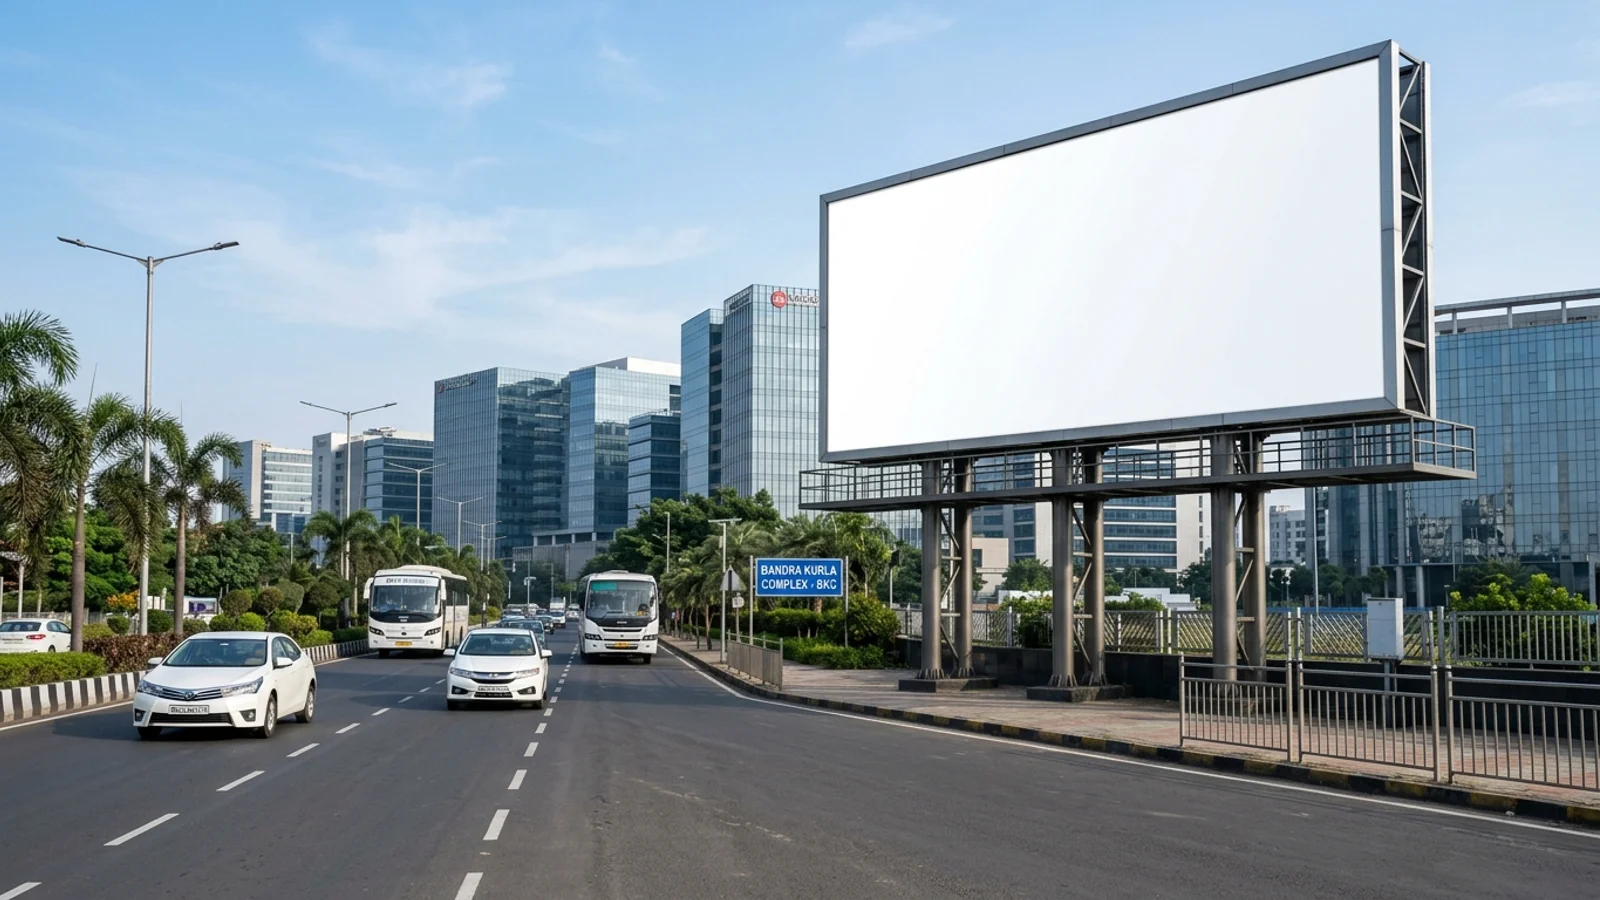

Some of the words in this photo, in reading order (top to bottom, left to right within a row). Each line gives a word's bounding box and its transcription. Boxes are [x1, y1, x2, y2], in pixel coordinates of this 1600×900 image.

[761, 565, 802, 575] BANDRA
[804, 565, 837, 575] KURLA
[761, 579, 808, 589] COMPLEX
